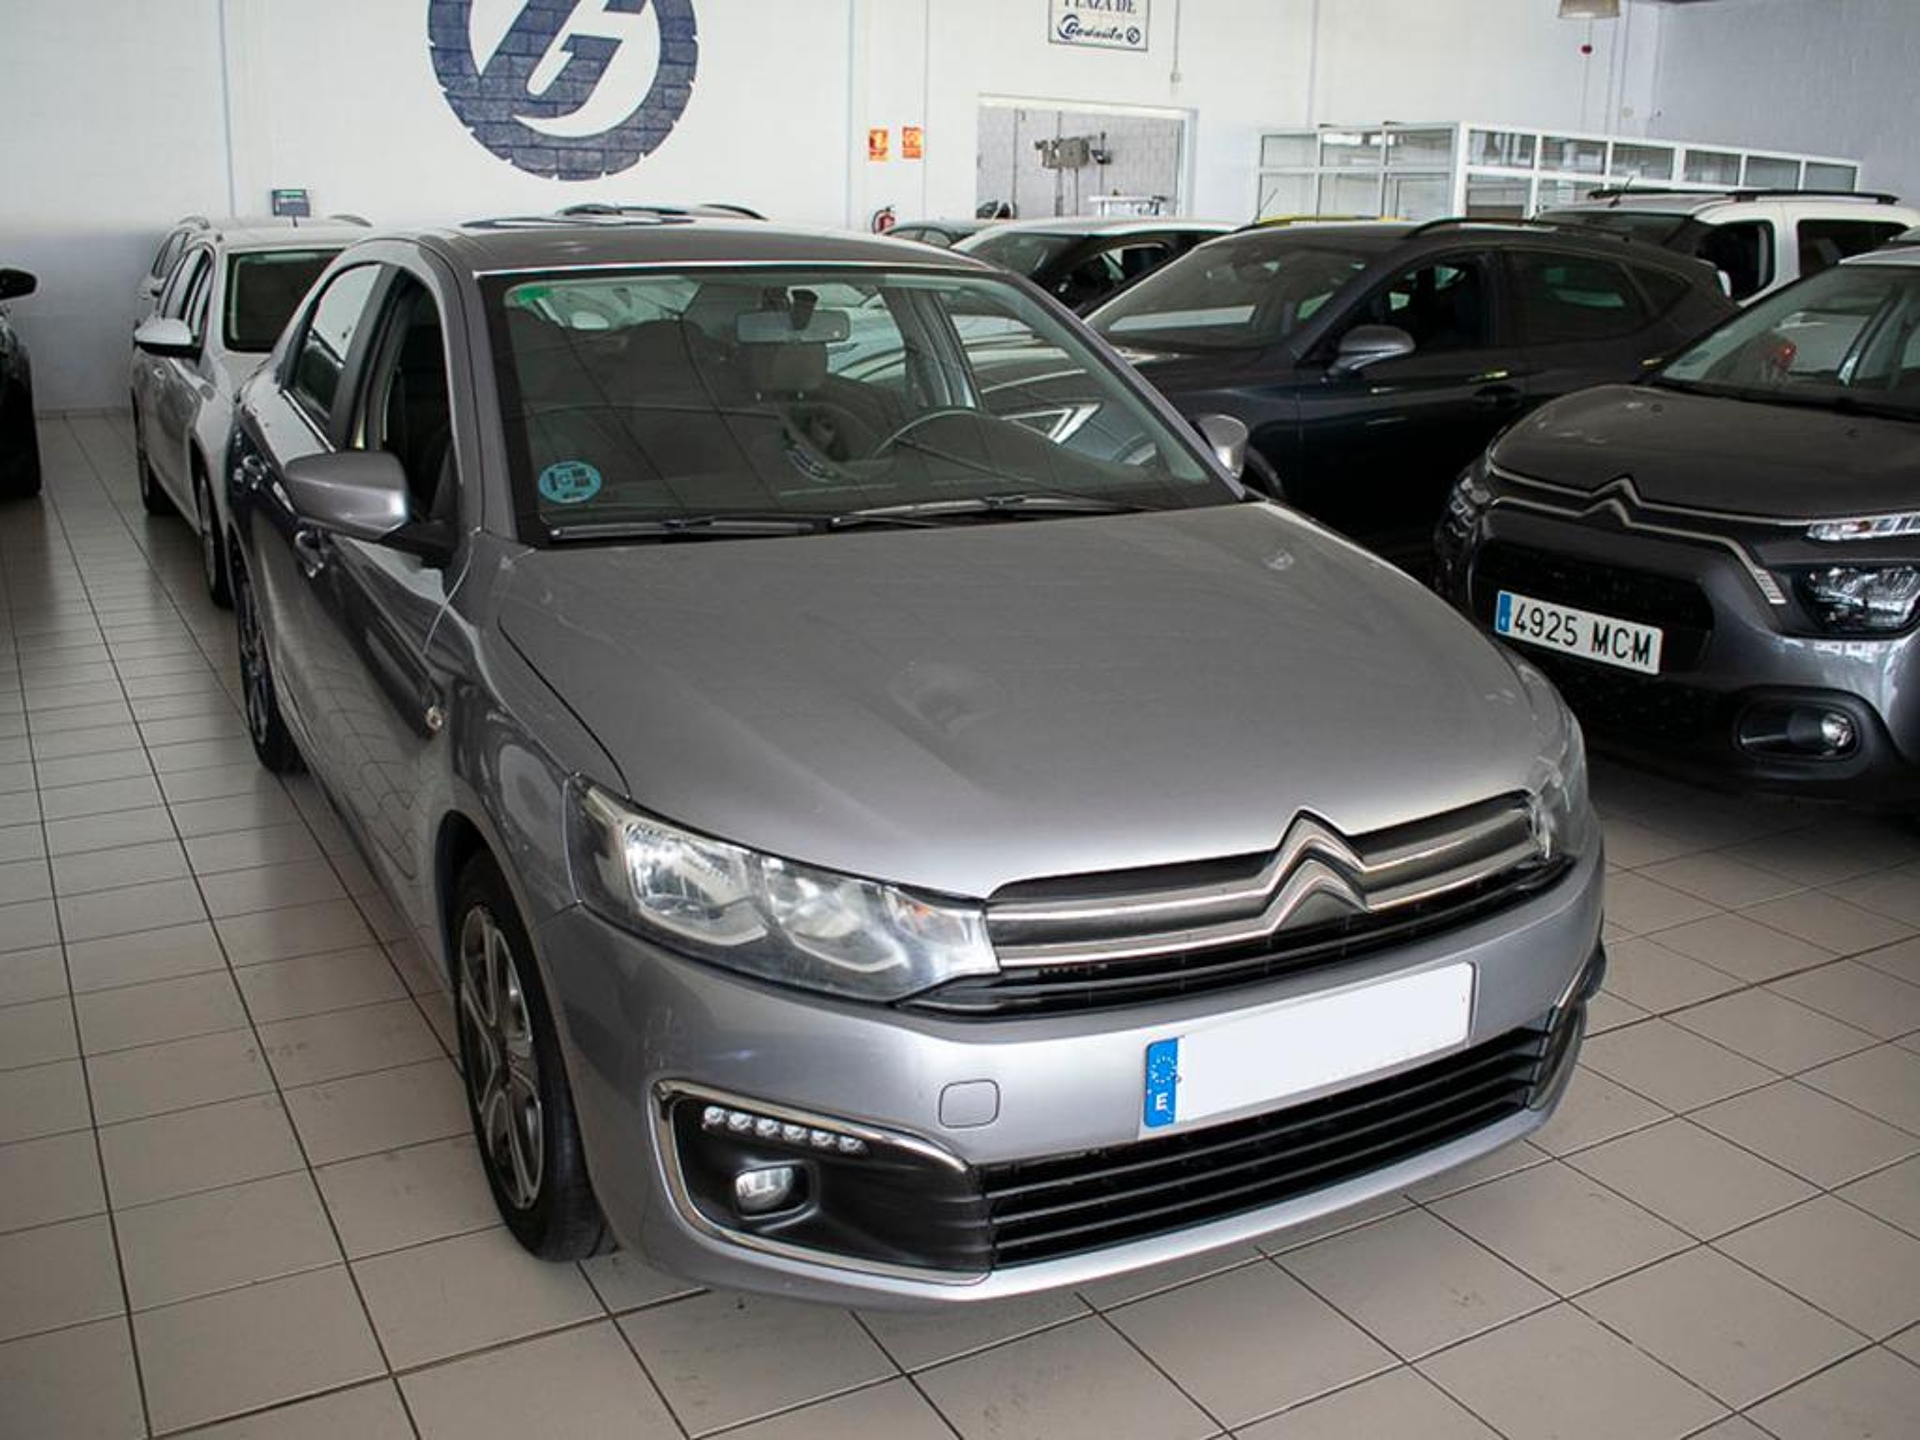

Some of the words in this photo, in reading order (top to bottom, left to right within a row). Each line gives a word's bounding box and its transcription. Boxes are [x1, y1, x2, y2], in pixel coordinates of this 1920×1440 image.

[1514, 603, 1578, 647] 4925
[1590, 622, 1652, 665] MCM
[1155, 1092, 1169, 1111] E
